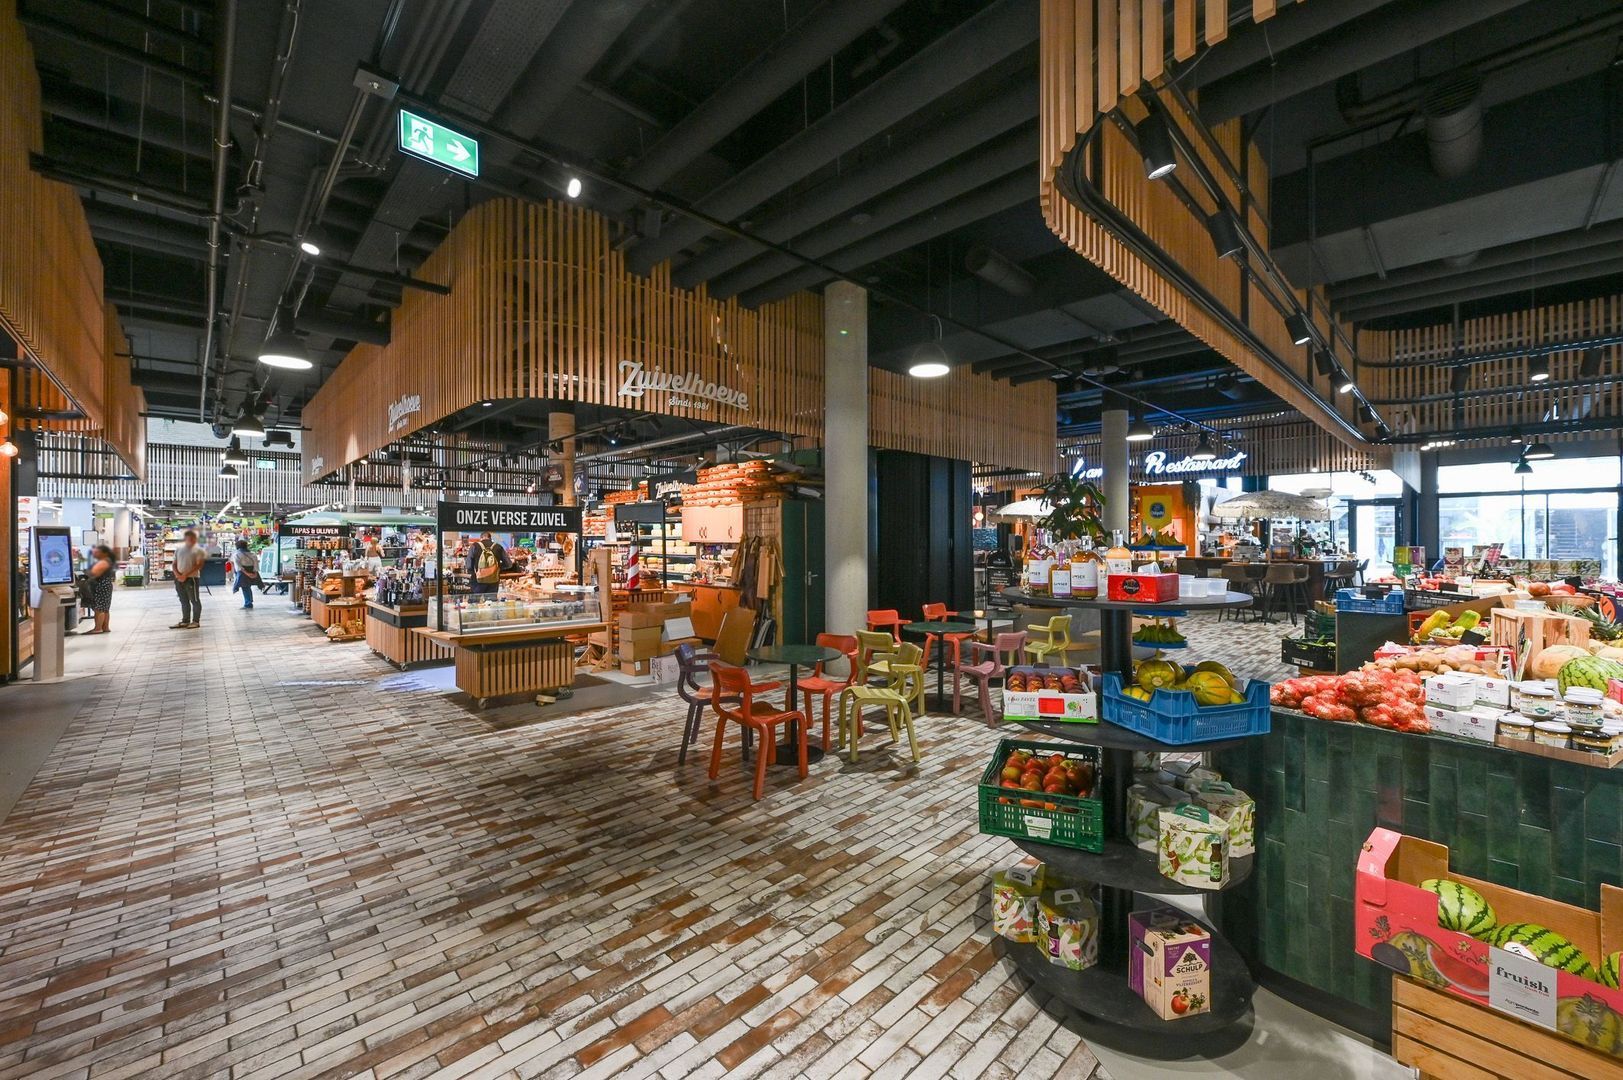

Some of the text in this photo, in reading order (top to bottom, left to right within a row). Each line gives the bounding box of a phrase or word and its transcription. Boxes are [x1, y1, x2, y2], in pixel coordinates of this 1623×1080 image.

[618, 360, 749, 411] Zuivelhoeve
[668, 395, 710, 411] Sinds 1981
[1145, 451, 1247, 474] Restaurant
[456, 509, 567, 527] ONZE VERSE ZUIVEL
[1176, 963, 1203, 973] SCHULP
[1496, 966, 1549, 994] fruish
